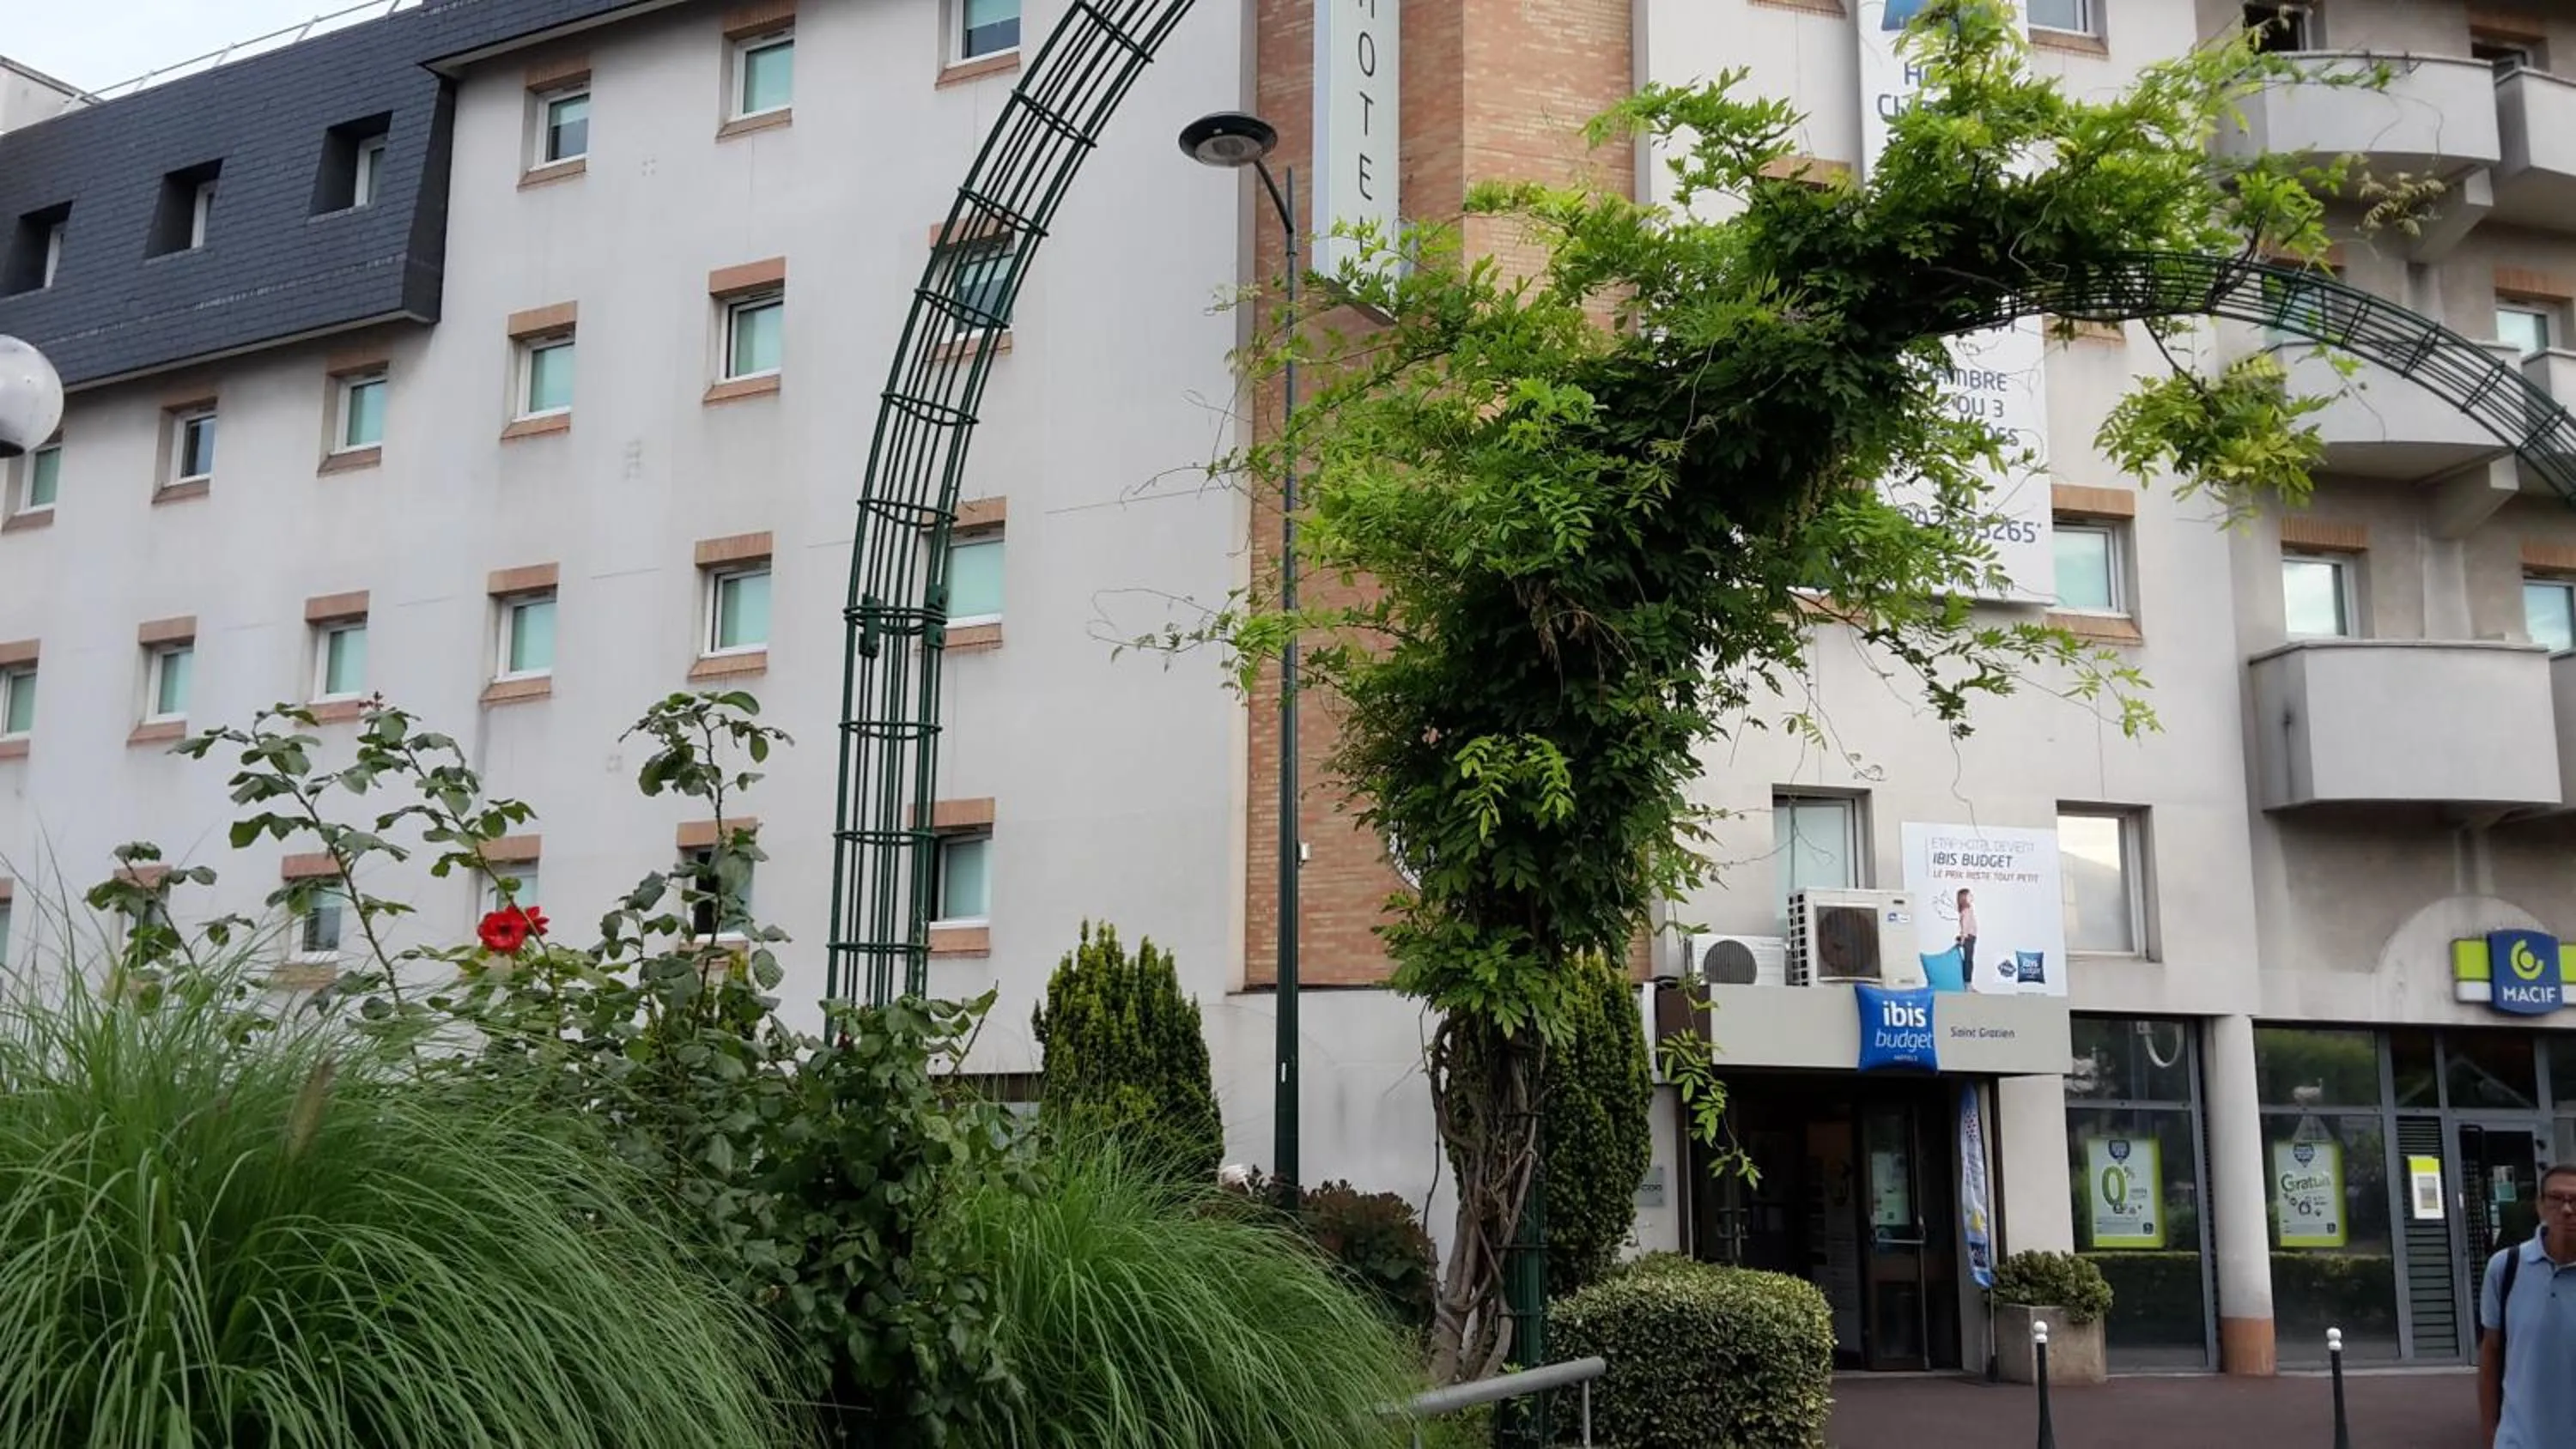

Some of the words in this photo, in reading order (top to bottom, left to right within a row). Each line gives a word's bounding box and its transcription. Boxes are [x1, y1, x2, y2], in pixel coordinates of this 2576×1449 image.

[1923, 363, 2008, 392] AMBRE
[1956, 395, 1986, 416] OU
[1992, 399, 2005, 418] 3
[1933, 852, 1958, 866] IBIS
[1961, 853, 2013, 869] BUDGET
[2502, 985, 2556, 1003] MACIF
[1882, 1000, 1927, 1028] ibis
[1874, 1029, 1933, 1053] budget
[1950, 1026, 1976, 1038] Saint
